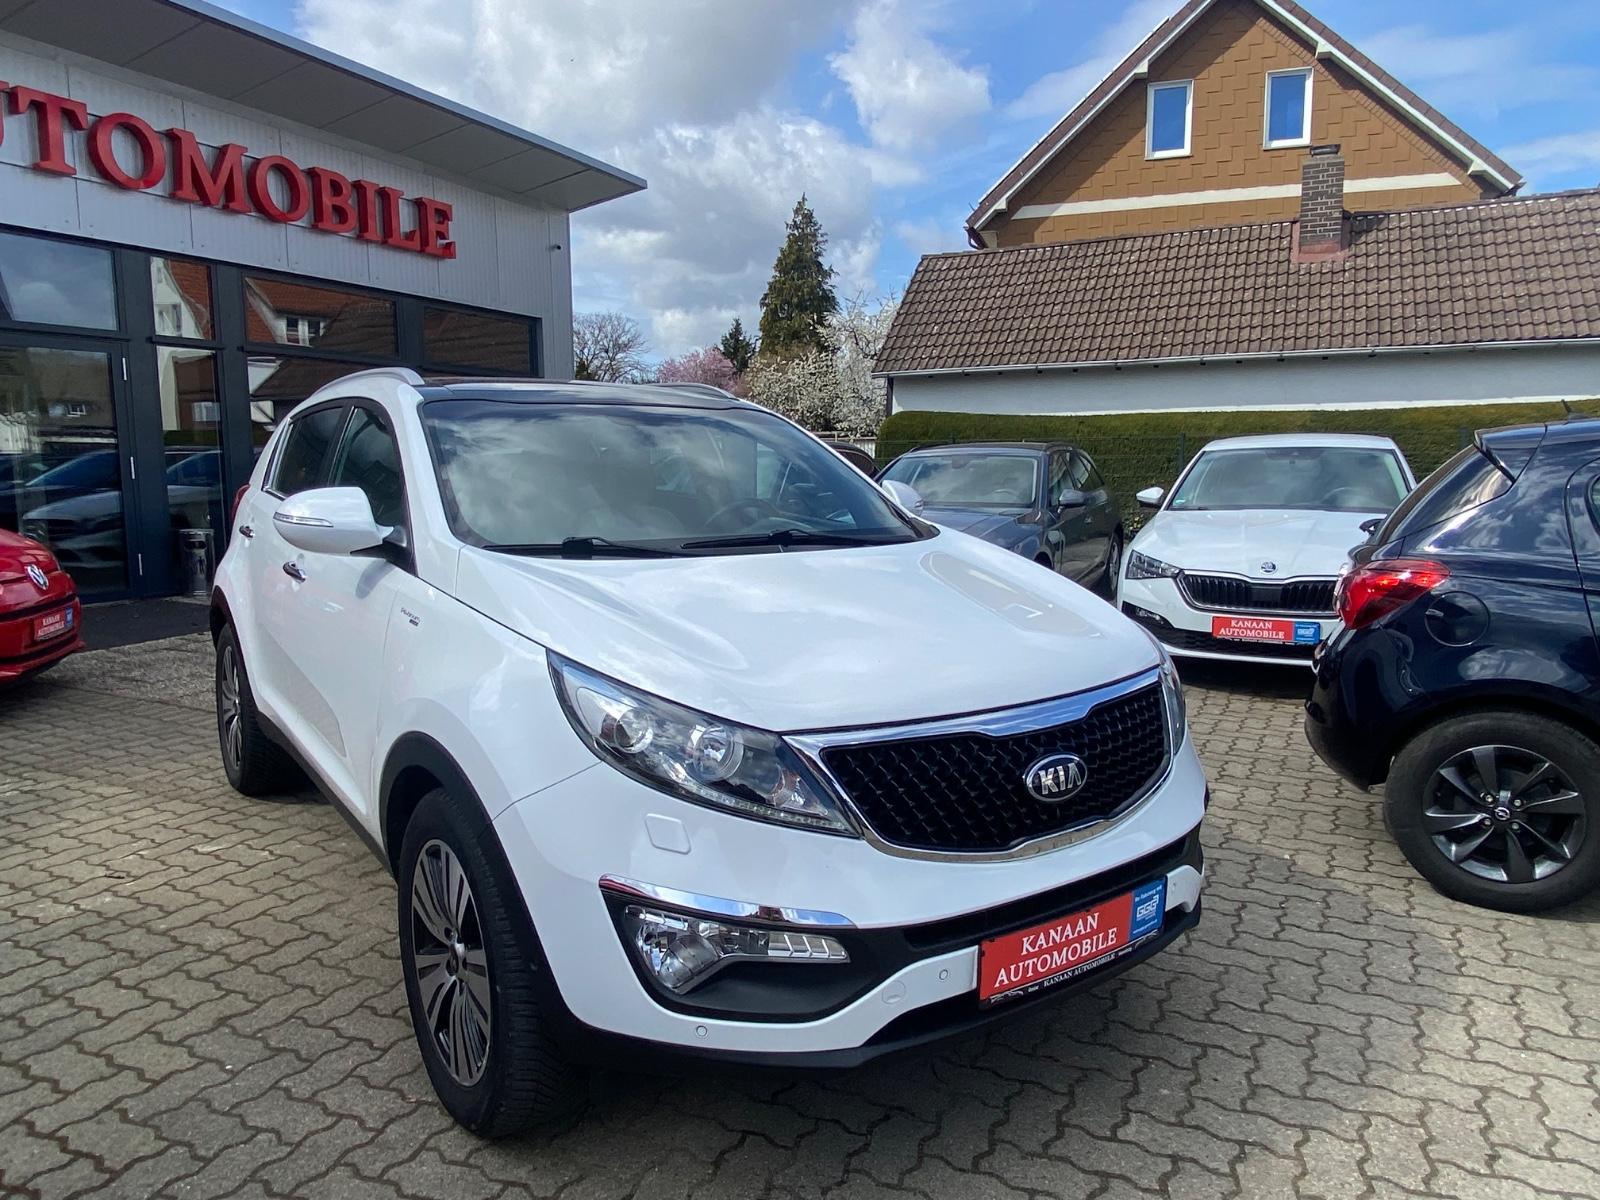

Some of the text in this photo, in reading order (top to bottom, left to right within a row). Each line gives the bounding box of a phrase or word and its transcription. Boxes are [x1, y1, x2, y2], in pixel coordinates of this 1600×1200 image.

[0, 80, 456, 259] TOMOBILE
[1219, 628, 1285, 639] AUTOMOBILE
[1231, 619, 1273, 630] KANAAN
[1038, 763, 1081, 794] KIA
[1021, 913, 1100, 956] KANAAN
[994, 927, 1117, 988] AUTOMOBILE
